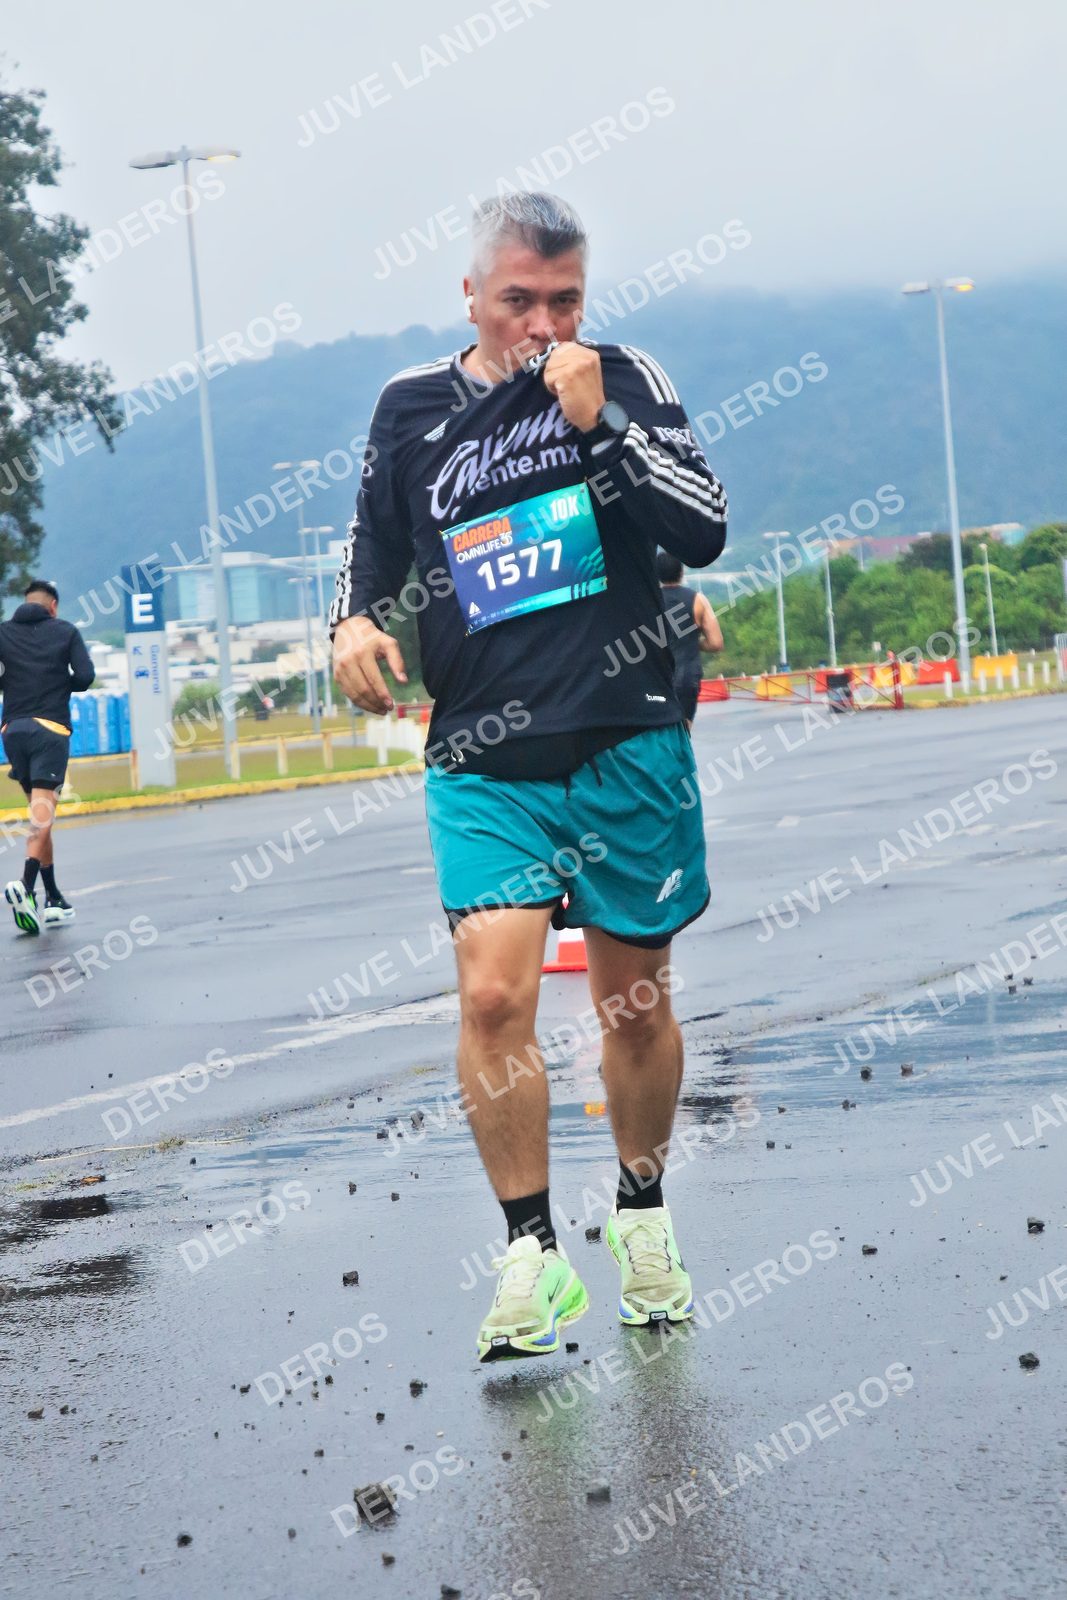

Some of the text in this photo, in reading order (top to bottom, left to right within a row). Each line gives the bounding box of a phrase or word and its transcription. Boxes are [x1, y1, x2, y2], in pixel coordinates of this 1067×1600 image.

[550, 494, 580, 521] 10K
[453, 516, 512, 553] CARRERA
[477, 538, 563, 592] 1577
[131, 592, 155, 625] E
